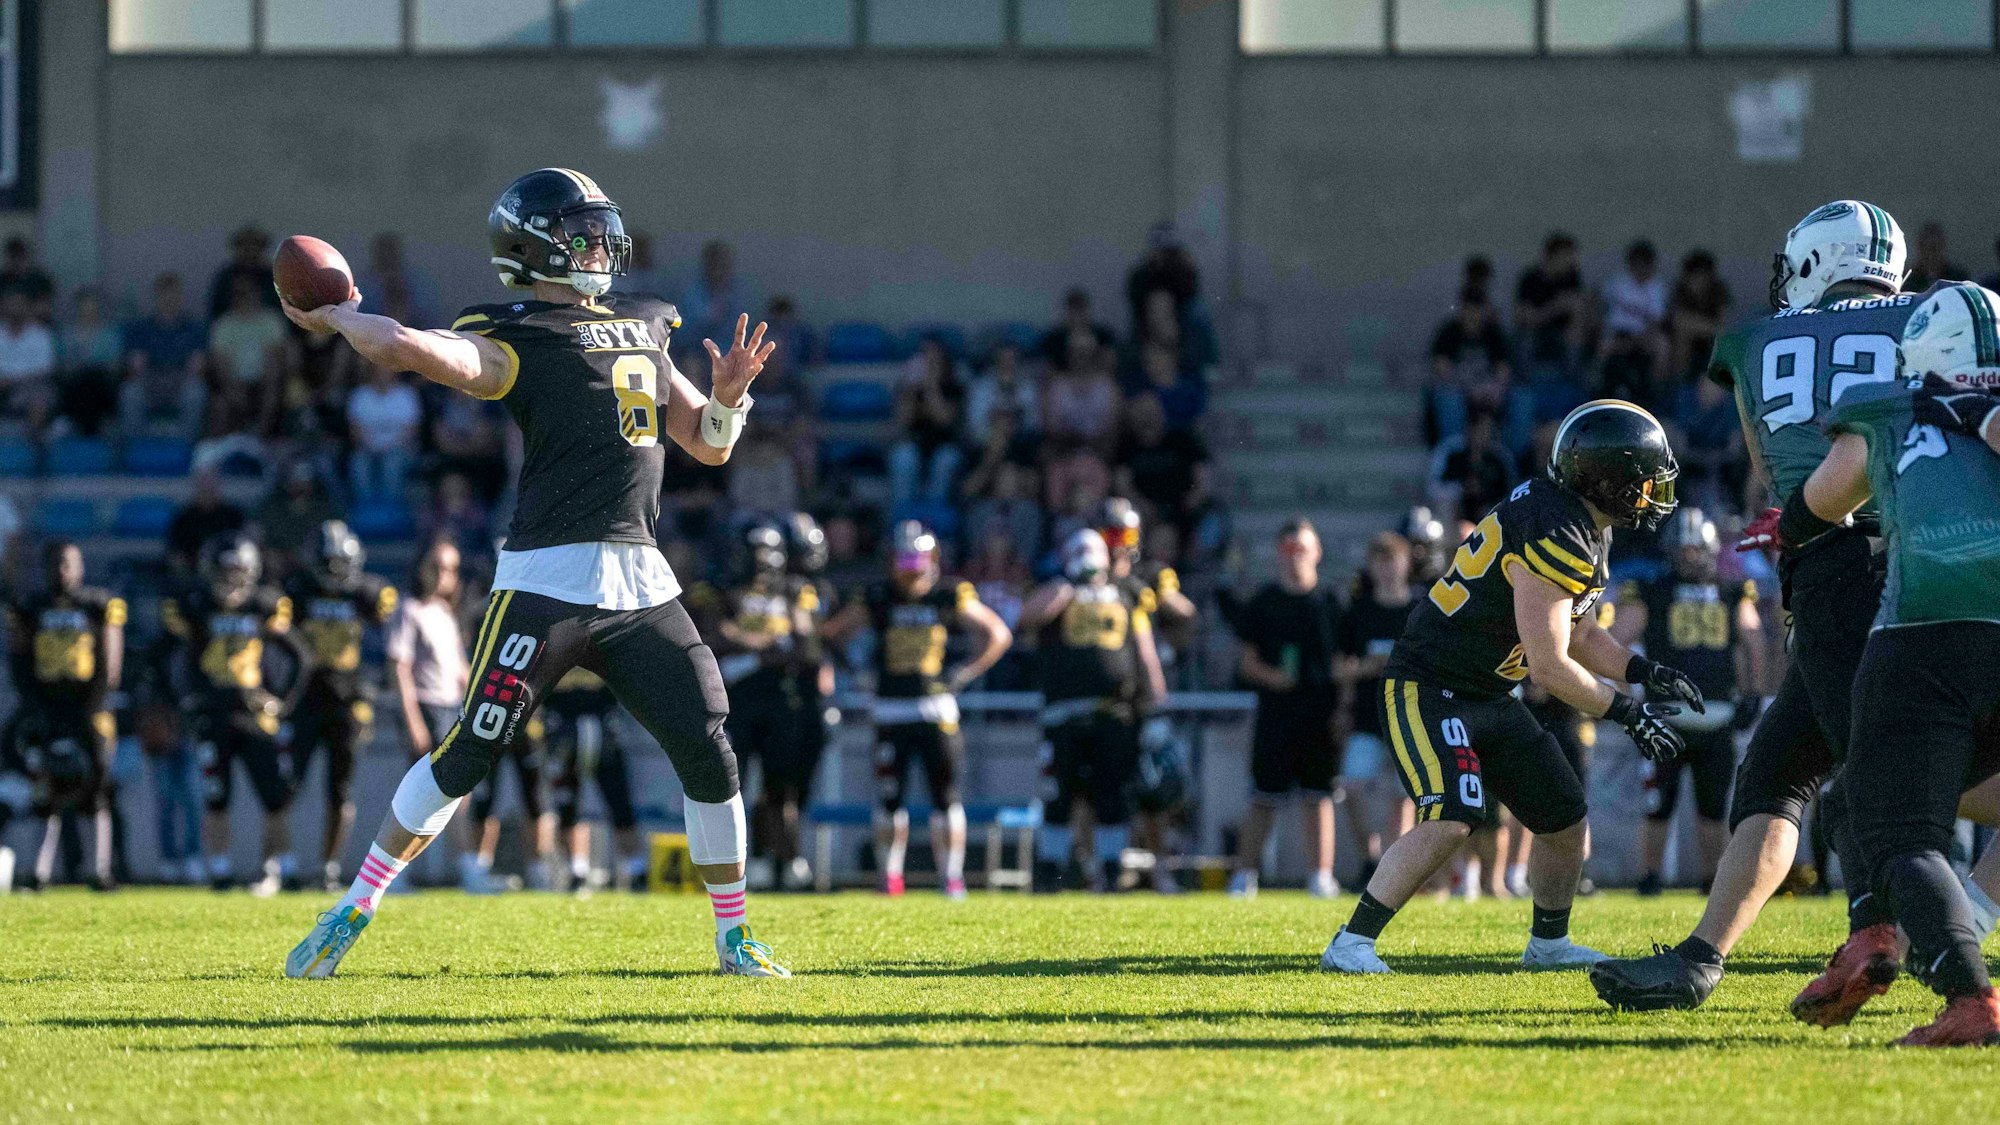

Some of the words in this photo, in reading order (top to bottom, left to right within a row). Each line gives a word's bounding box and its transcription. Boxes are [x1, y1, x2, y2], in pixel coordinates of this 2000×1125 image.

[1863, 265, 1898, 283] schutt
[576, 324, 597, 349] das
[589, 321, 658, 349] GYM
[1761, 333, 1899, 434] 92
[1955, 371, 2000, 387] Ridd
[611, 354, 659, 447] 8
[502, 700, 526, 745] WOHNBAU
